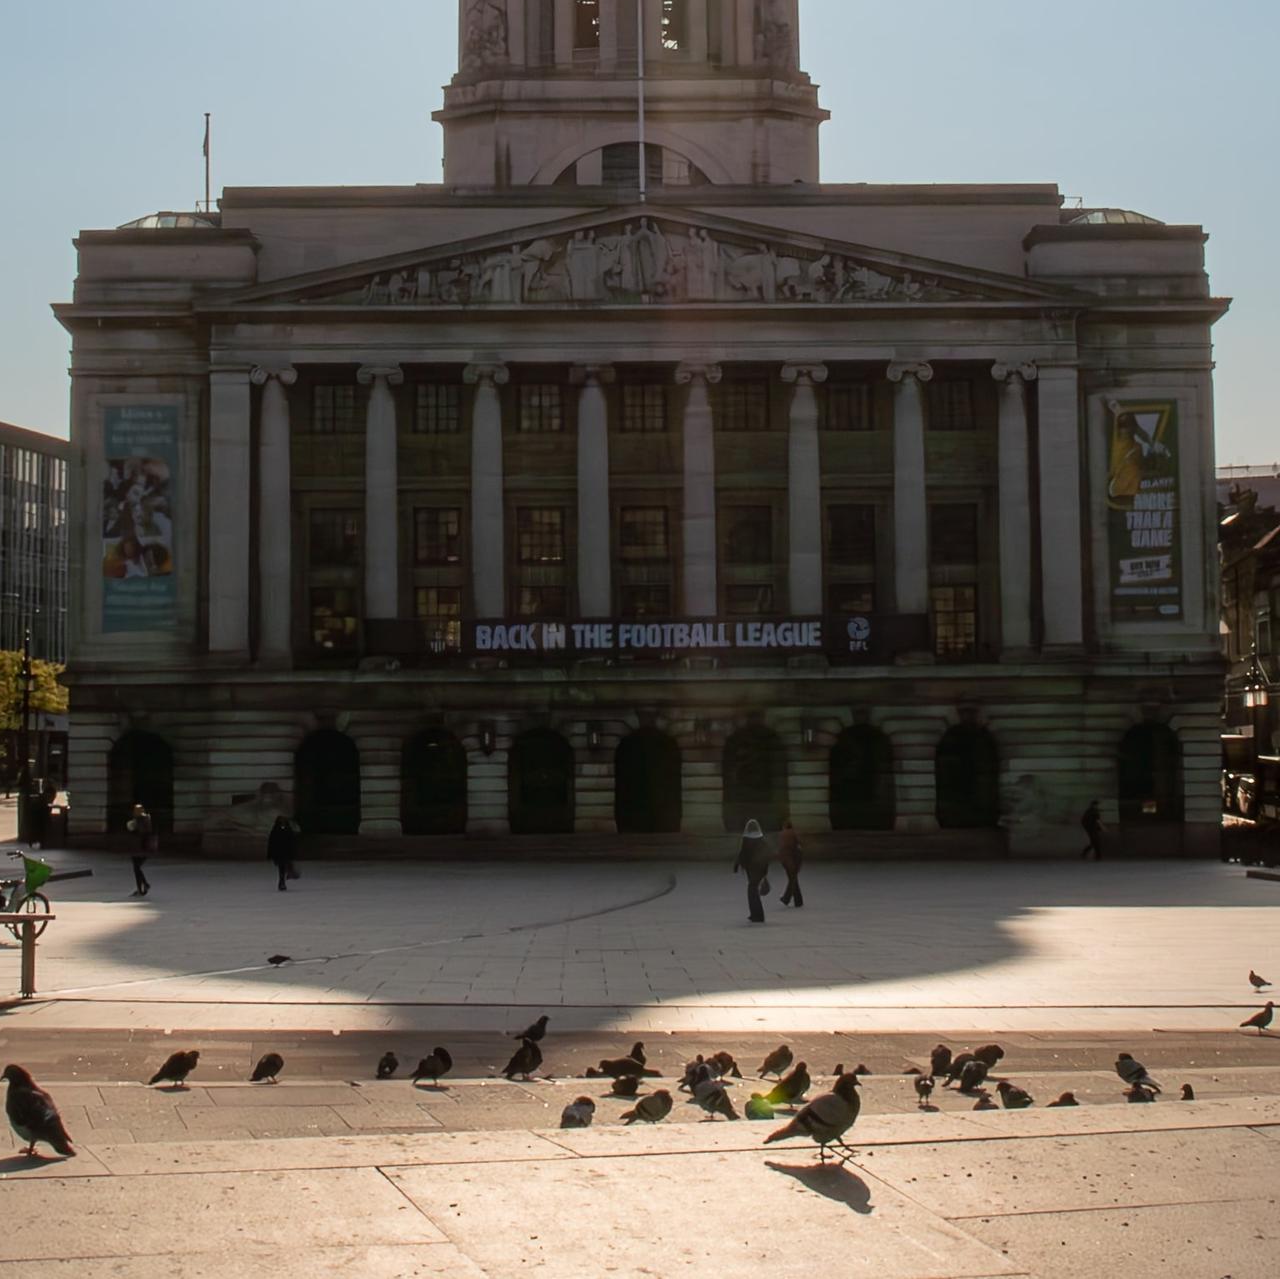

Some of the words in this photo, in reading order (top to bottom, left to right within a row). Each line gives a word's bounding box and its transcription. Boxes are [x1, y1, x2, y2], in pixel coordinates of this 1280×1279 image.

[1134, 492, 1175, 510] MORE
[1126, 512, 1161, 529] THAN
[1163, 511, 1173, 528] A
[1131, 529, 1173, 547] GAME
[475, 624, 536, 650] BACK
[542, 623, 566, 649] IN
[571, 623, 614, 650] THE
[618, 622, 730, 649] FOOTBALL
[735, 622, 822, 647] LEAGUE
